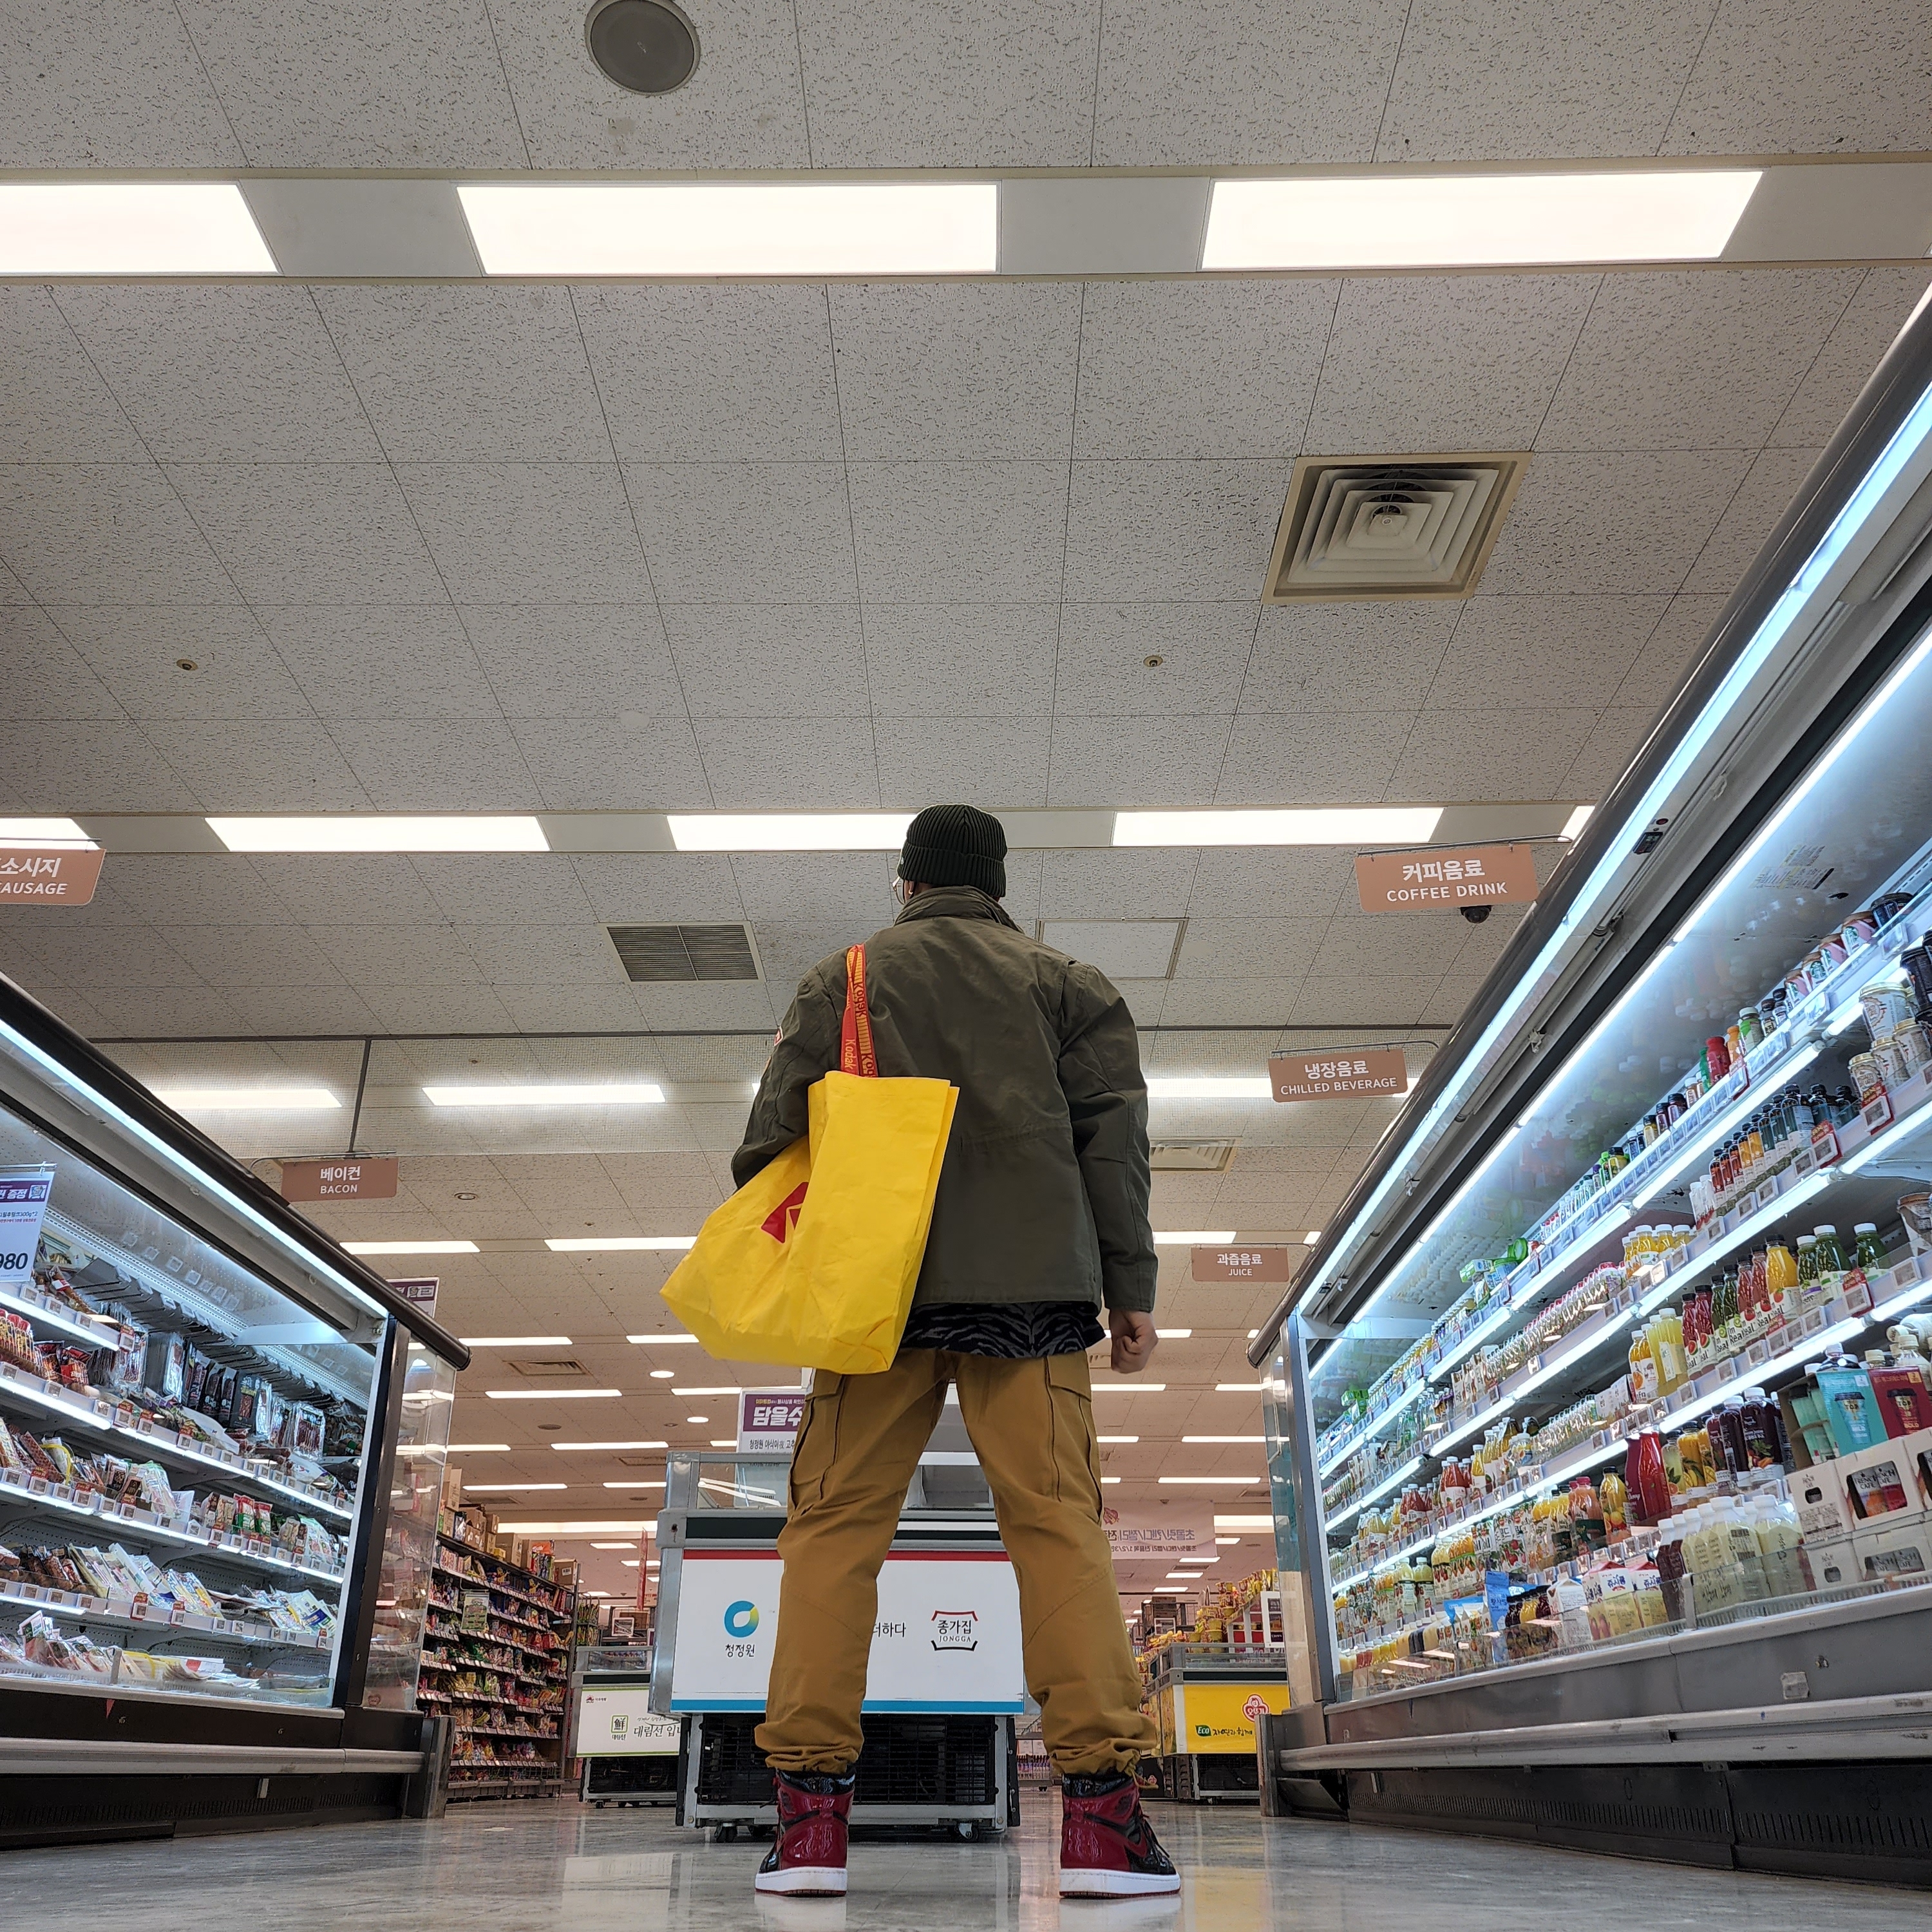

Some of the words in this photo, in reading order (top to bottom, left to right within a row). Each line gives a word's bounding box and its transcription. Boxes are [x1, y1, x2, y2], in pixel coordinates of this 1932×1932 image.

[1402, 859, 1486, 883] 커피음료
[0, 882, 68, 895] AUSAGE
[1387, 886, 1451, 902] COFFEE
[1456, 882, 1508, 897] DRINK
[844, 1039, 857, 1070] Kodak
[1304, 1060, 1369, 1079] 냉장음료
[1280, 1083, 1330, 1095] CHILLED
[1334, 1077, 1397, 1091] BEVERAGE
[320, 1166, 361, 1182] 베이컨
[320, 1184, 357, 1194] BACON
[1217, 1253, 1263, 1266] 과즙음료
[750, 1439, 764, 1449] 청정원
[937, 1620, 972, 1634] 종가집
[725, 1644, 755, 1658] 청정원
[634, 1725, 663, 1738] 대림선
